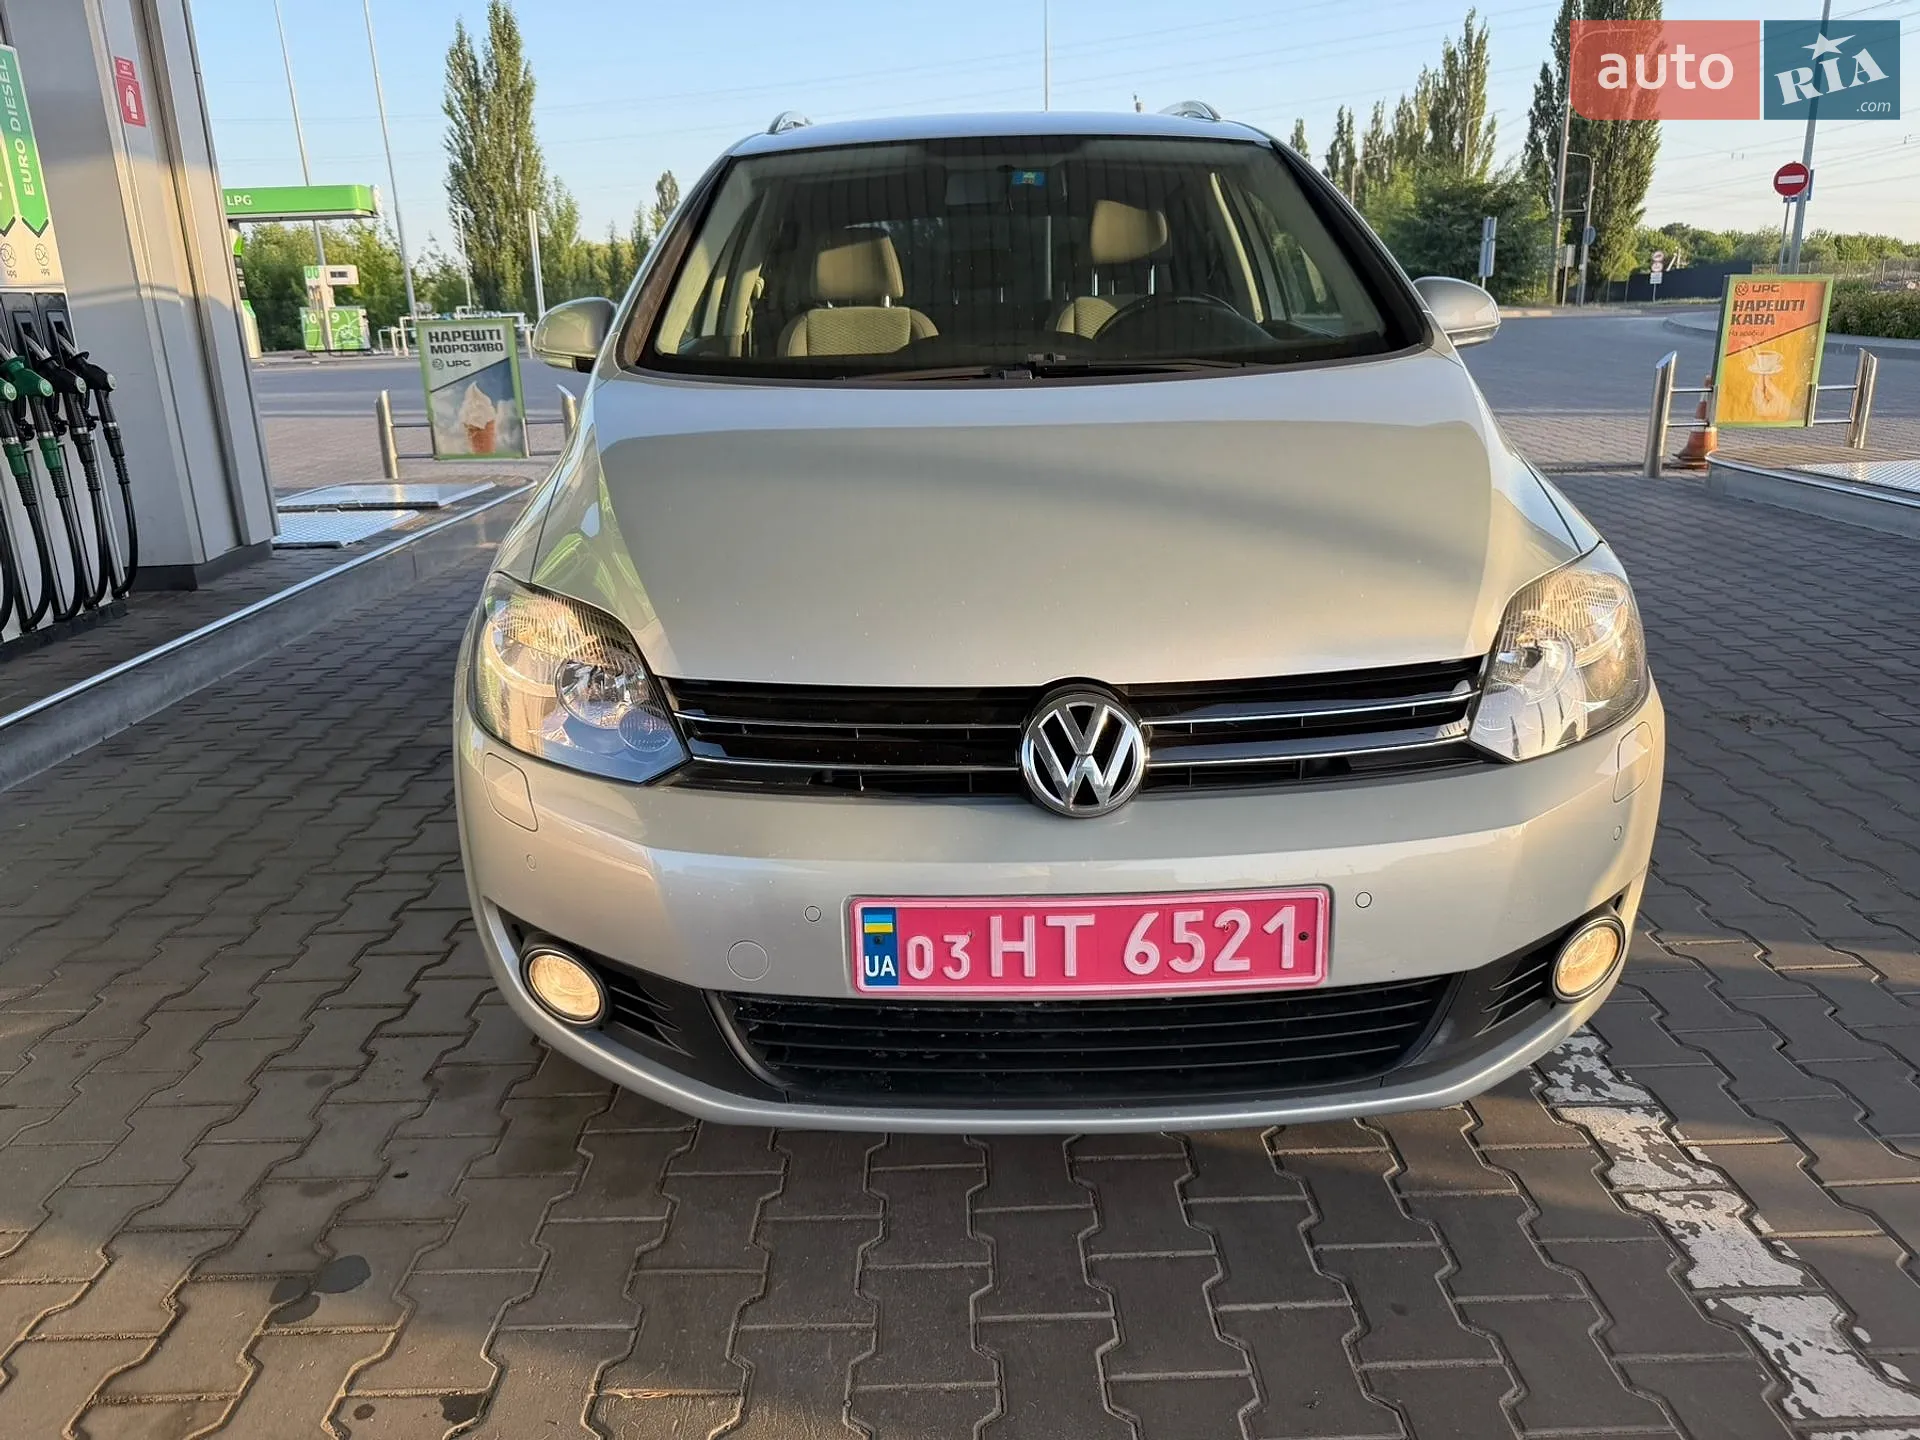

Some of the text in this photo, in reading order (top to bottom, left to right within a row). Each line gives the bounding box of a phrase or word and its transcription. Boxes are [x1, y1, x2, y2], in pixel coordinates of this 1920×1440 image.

[15, 138, 35, 196] EURO
[226, 194, 253, 206] LPG
[1732, 299, 1805, 312] НАРЕШТІ
[1730, 313, 1776, 325] КАВА
[428, 328, 501, 343] НАРЕШТІ
[430, 342, 504, 354] МОРОЗИВО
[446, 359, 472, 367] UPG
[905, 905, 1297, 980] 03 HT 6521
[864, 954, 896, 977] UA
